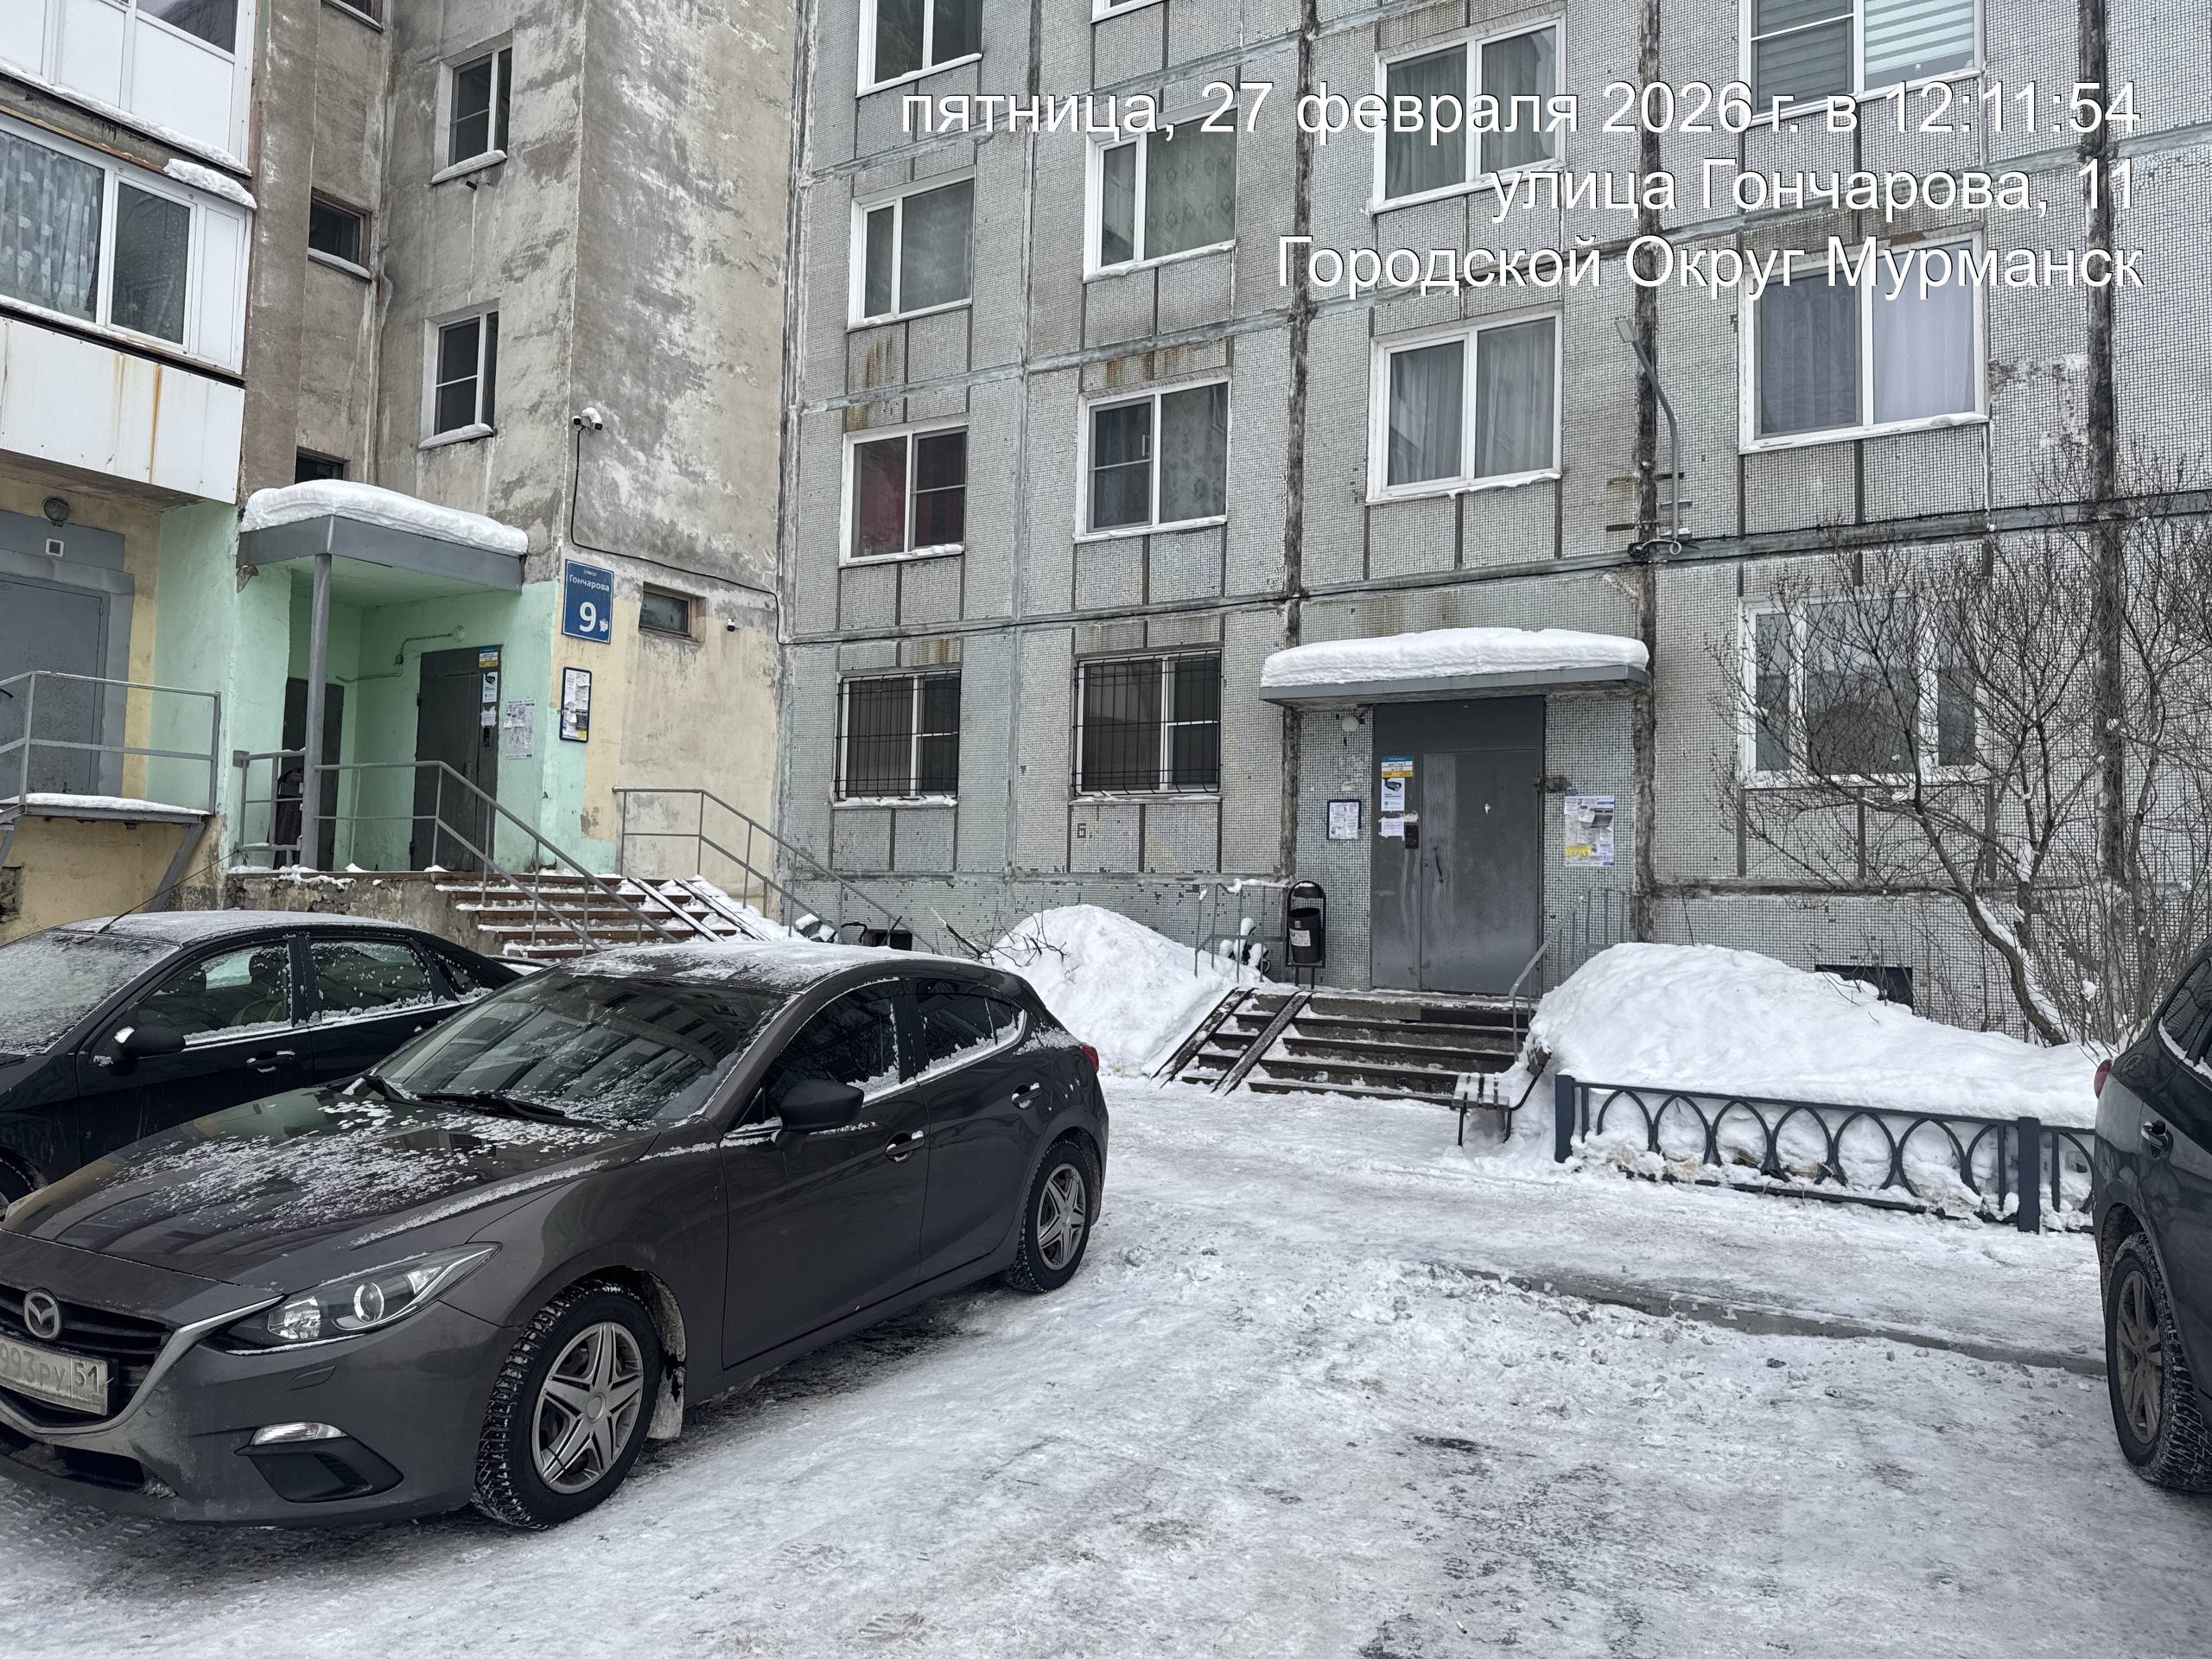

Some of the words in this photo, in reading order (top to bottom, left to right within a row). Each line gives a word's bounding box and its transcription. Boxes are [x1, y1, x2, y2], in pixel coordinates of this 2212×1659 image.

[569, 575, 609, 592] Гончарова
[579, 601, 596, 632] 9
[74, 1362, 99, 1392] 51
